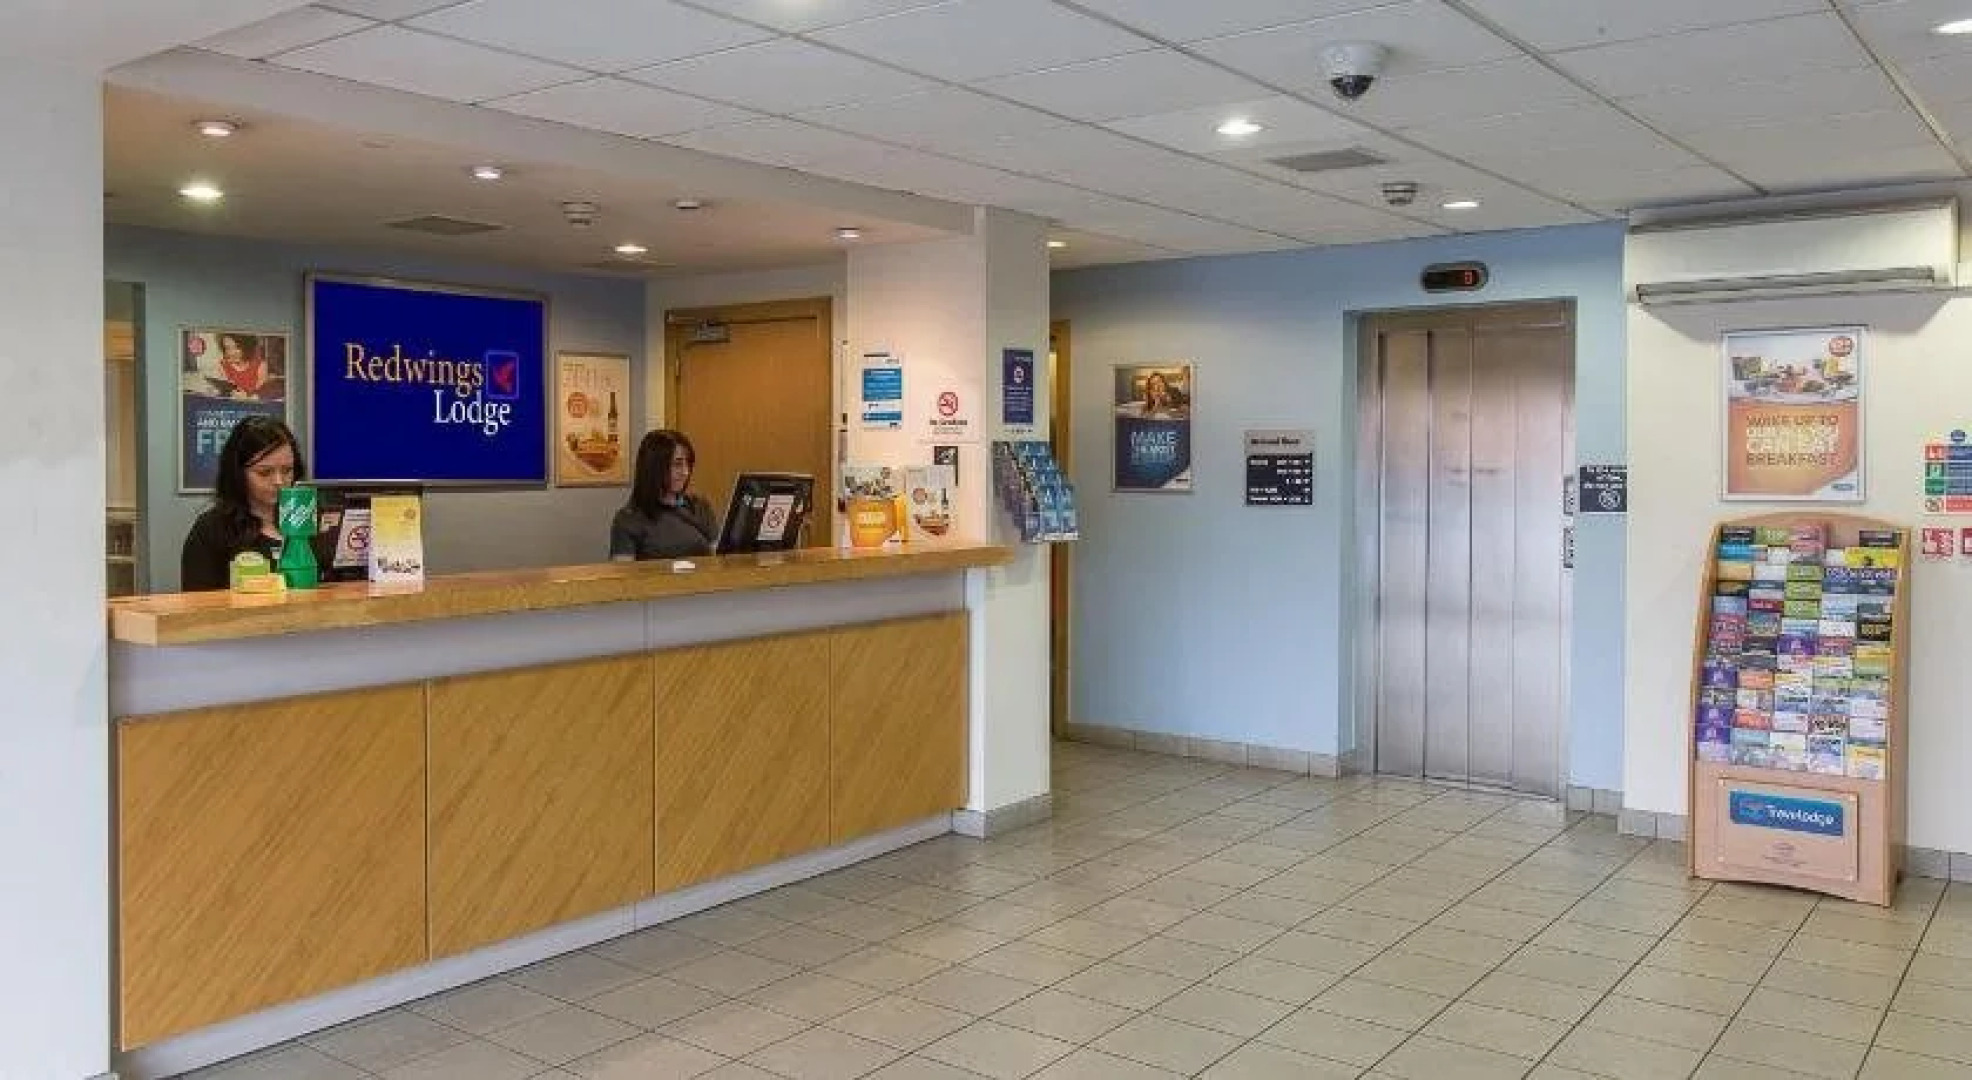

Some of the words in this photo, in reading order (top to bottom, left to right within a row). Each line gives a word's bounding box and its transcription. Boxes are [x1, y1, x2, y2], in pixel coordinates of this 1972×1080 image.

[344, 342, 485, 398] Redwings
[433, 389, 513, 436] Lodge
[1746, 415, 1790, 426] WAKE
[1795, 415, 1815, 426] UP
[1819, 415, 1840, 426] TO
[1131, 431, 1177, 446] MAKE
[1746, 453, 1840, 466] BREAKFAST
[1765, 804, 1835, 828] Travelodge
